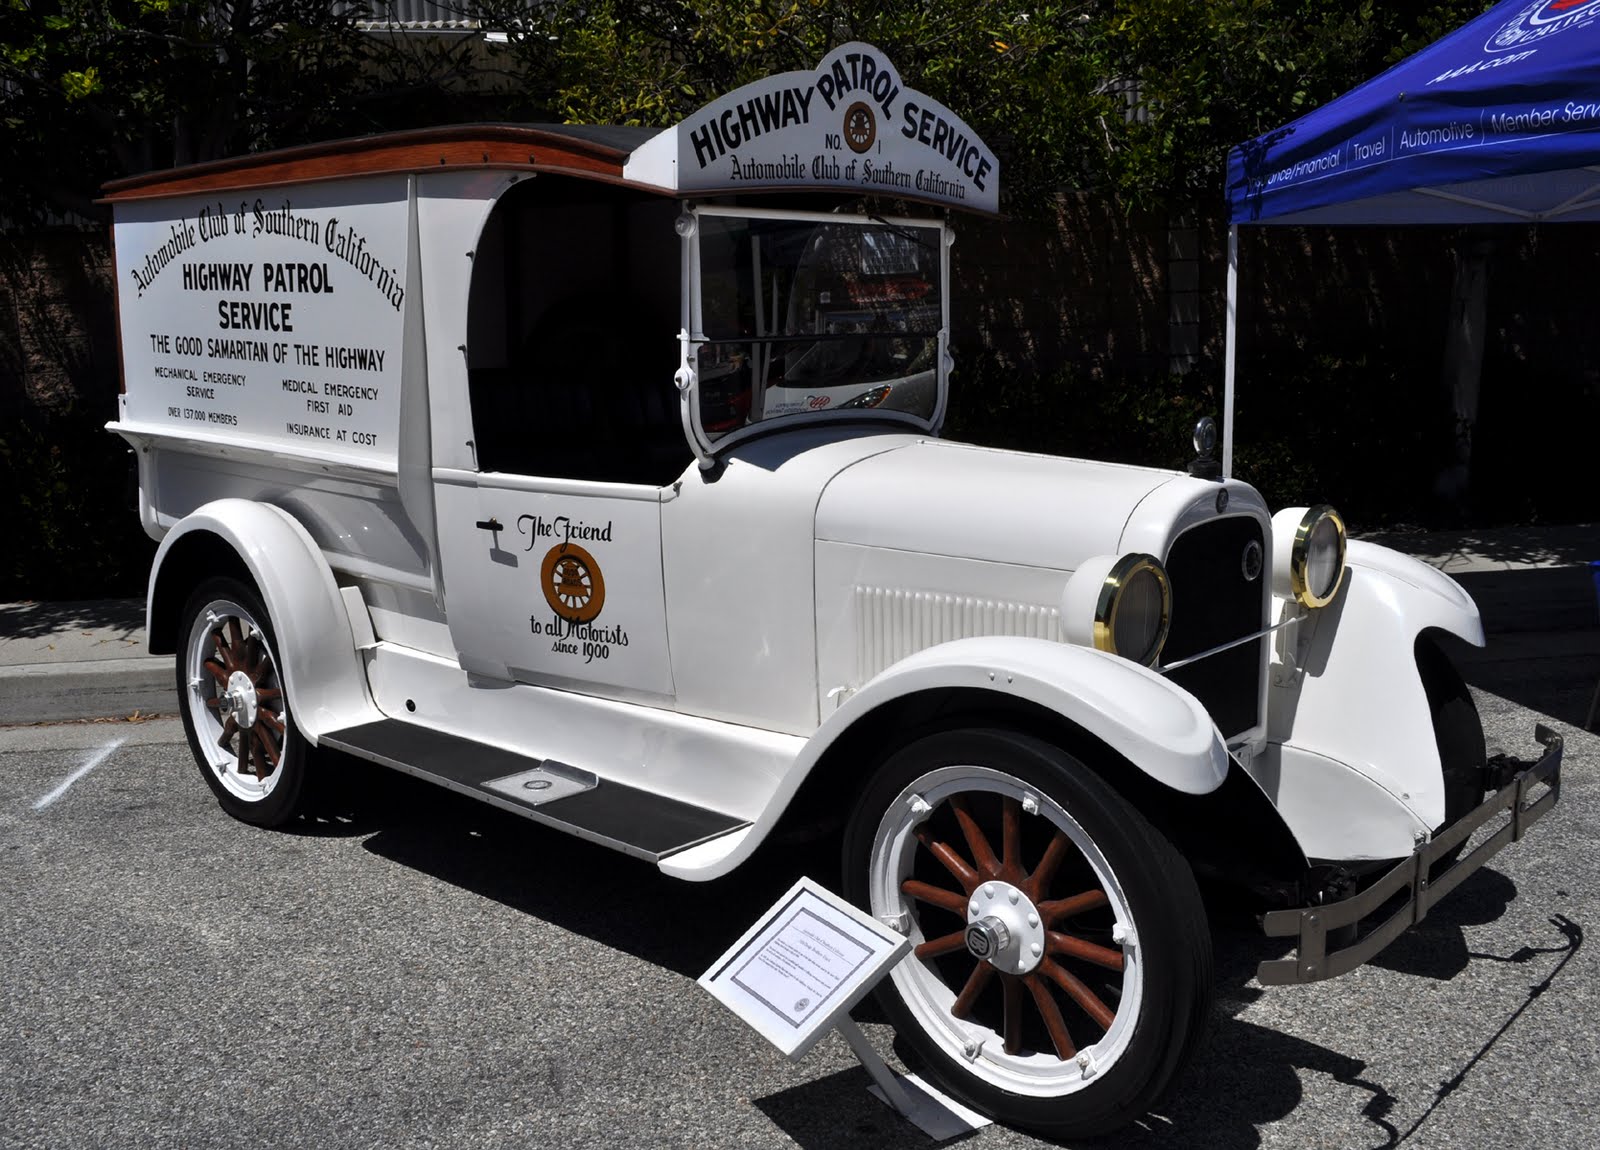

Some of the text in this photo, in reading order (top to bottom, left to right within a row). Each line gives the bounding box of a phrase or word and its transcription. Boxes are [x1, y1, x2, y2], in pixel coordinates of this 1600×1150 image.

[690, 53, 992, 192] HIGHWAY PATROL SERVICE
[1353, 136, 1385, 161] Travel
[1400, 121, 1475, 151] Automotive
[1491, 107, 1560, 134] Member
[825, 133, 842, 150] NO.
[730, 153, 966, 200] Automobile Club of Southern California
[131, 198, 406, 312] Automobile Club of Southern California
[182, 263, 334, 294] HIGHWAY PATROL
[218, 300, 294, 333] SERVICE
[150, 334, 385, 373] THE GOOD SAMARITAN OF THE HIGHWAY
[154, 366, 246, 387] MECHANICAL EMERGENCY
[282, 379, 379, 401] MEDICAL EMERGENCY
[186, 386, 215, 400] SERVICE
[306, 399, 353, 417] FIRST AID
[168, 406, 181, 418] OVER
[208, 412, 238, 426] MEMBERS
[286, 423, 377, 447] INSURANCE AT COST
[517, 514, 612, 553] The Friend
[530, 615, 629, 646] to all Motorists
[551, 640, 610, 664] since 1900
